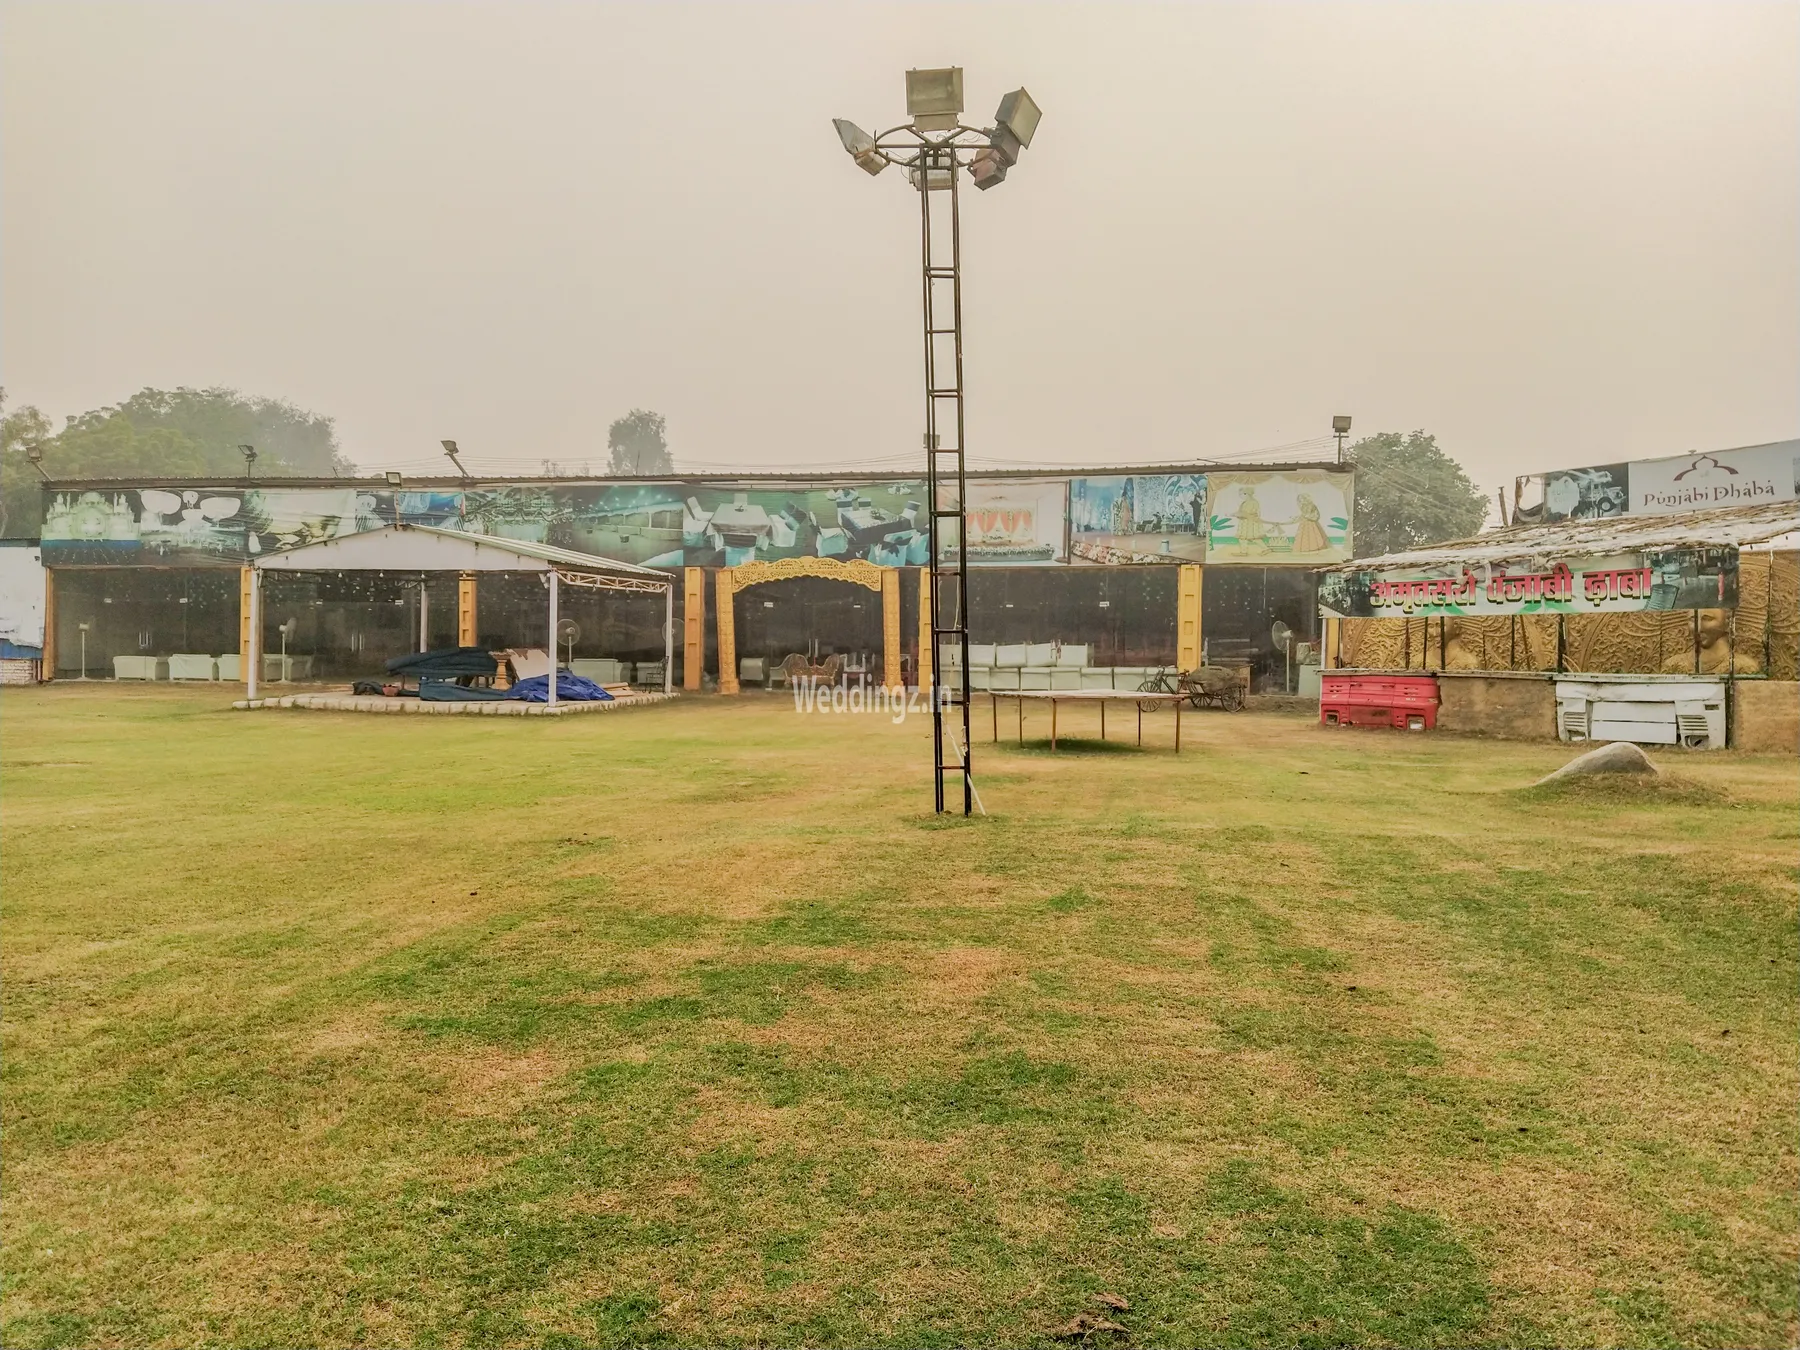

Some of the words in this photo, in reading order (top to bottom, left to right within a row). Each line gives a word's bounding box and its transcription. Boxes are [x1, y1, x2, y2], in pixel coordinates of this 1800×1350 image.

[1644, 487, 1708, 507] Punjabi
[1714, 480, 1775, 501] Dhaba
[1486, 563, 1574, 604] पंजाबी
